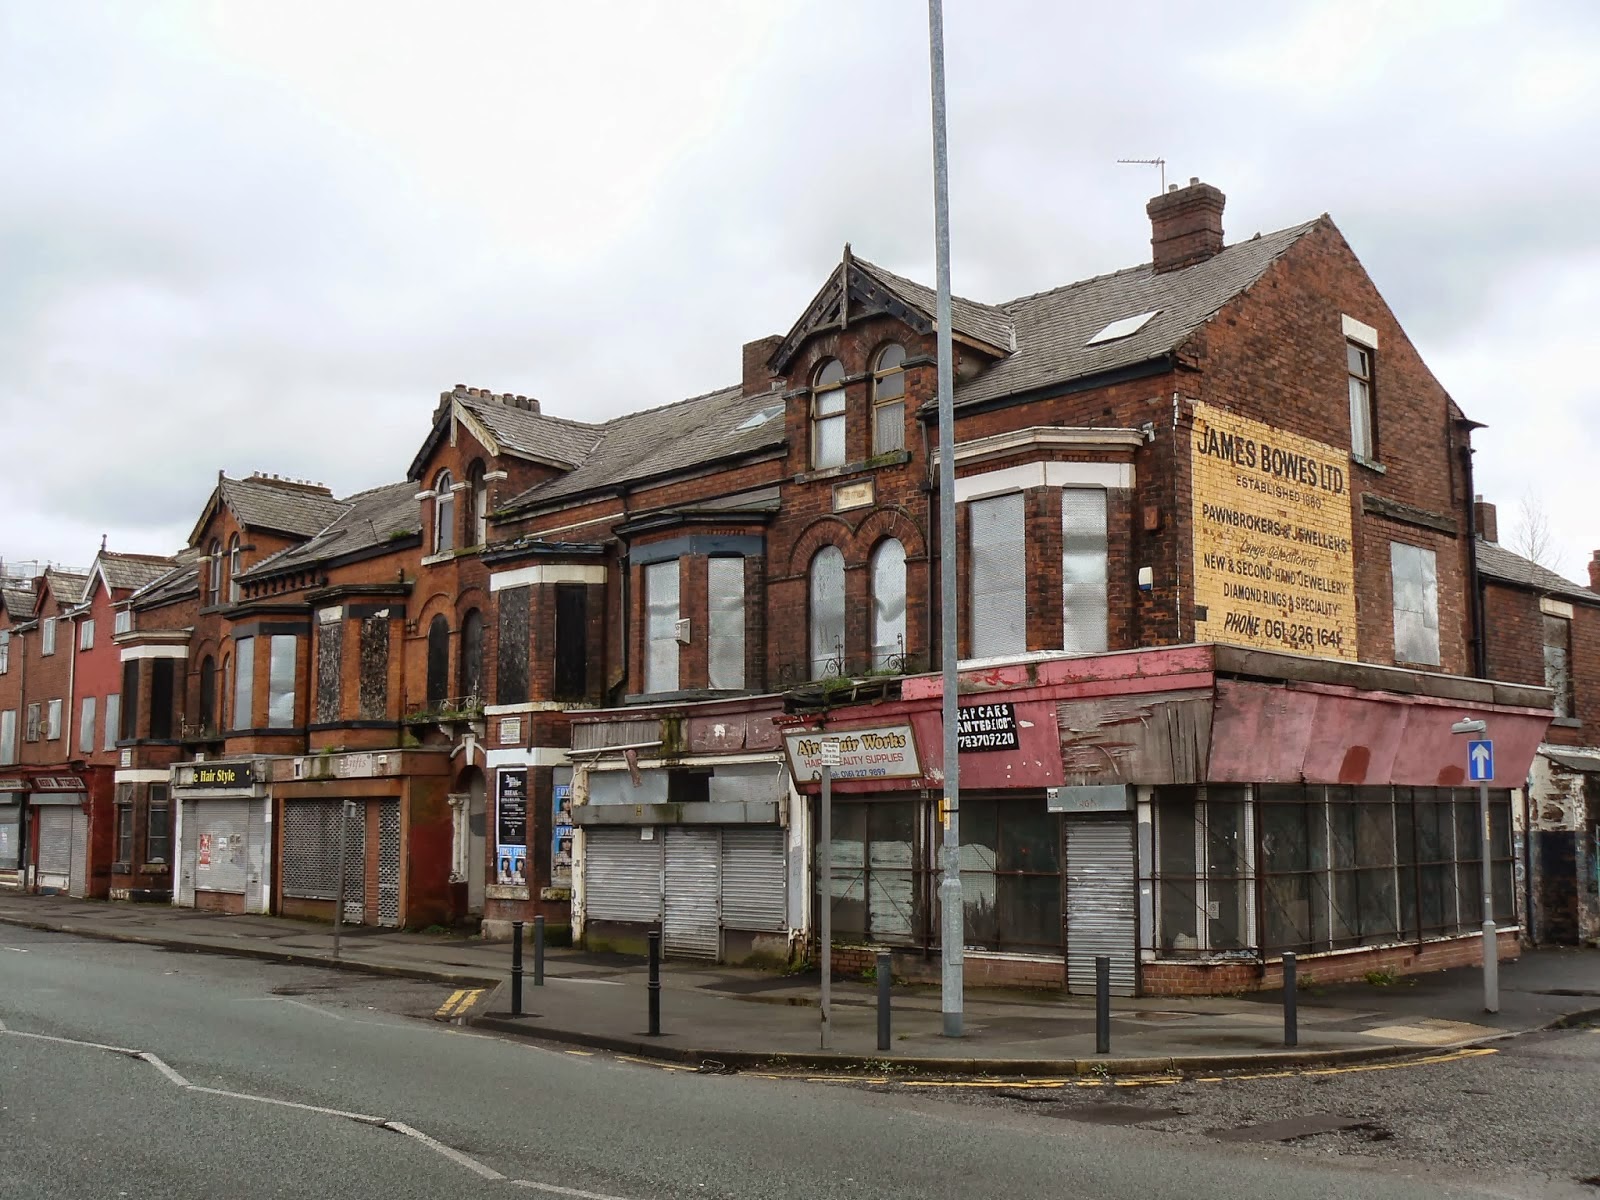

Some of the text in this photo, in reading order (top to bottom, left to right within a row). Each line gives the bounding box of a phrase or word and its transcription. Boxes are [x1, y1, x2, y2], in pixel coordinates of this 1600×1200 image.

[1197, 425, 1346, 496] JAMES BOWES LTD.
[1236, 475, 1300, 503] ESTABLISHED
[1202, 503, 1281, 537] PAWNBROKERS
[1292, 526, 1348, 554] JEWELLERS
[1240, 538, 1266, 560] Large
[1308, 556, 1320, 569] of
[1203, 553, 1226, 571] NEW
[1228, 559, 1235, 573] &
[1298, 573, 1348, 595] JEWELLERY
[1223, 582, 1262, 603] DIAMOND
[1263, 590, 1287, 608] RINGS
[1295, 597, 1339, 617] SPECIALITY
[1224, 612, 1261, 636] PHONE
[1290, 623, 1313, 645] 226
[977, 704, 1009, 718] CARS
[957, 719, 991, 734] ANTED
[861, 732, 906, 751] Works
[957, 732, 1015, 748] 783709220
[839, 755, 865, 767] EAUTY
[865, 752, 904, 765] SUPPLIES
[200, 769, 216, 783] Hair
[216, 769, 236, 785] Style
[856, 769, 867, 777] 227
[556, 827, 573, 836] FOXE
